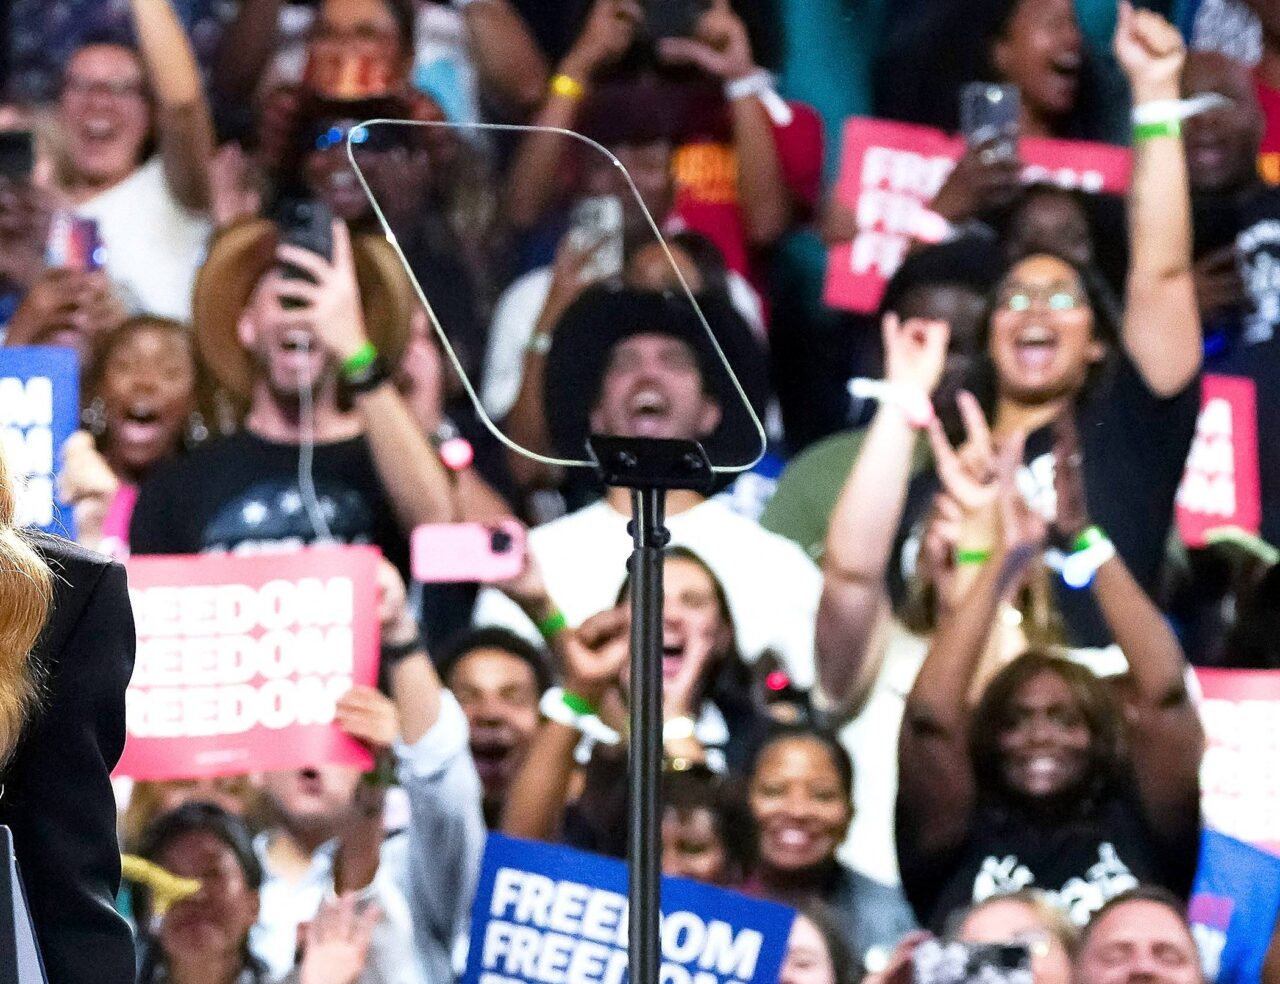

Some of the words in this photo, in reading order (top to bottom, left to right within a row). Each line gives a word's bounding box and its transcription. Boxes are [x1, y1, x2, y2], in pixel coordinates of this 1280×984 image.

[128, 577, 353, 633] EEDOM
[130, 625, 353, 685] EEDOM
[125, 676, 353, 738] EEDOM
